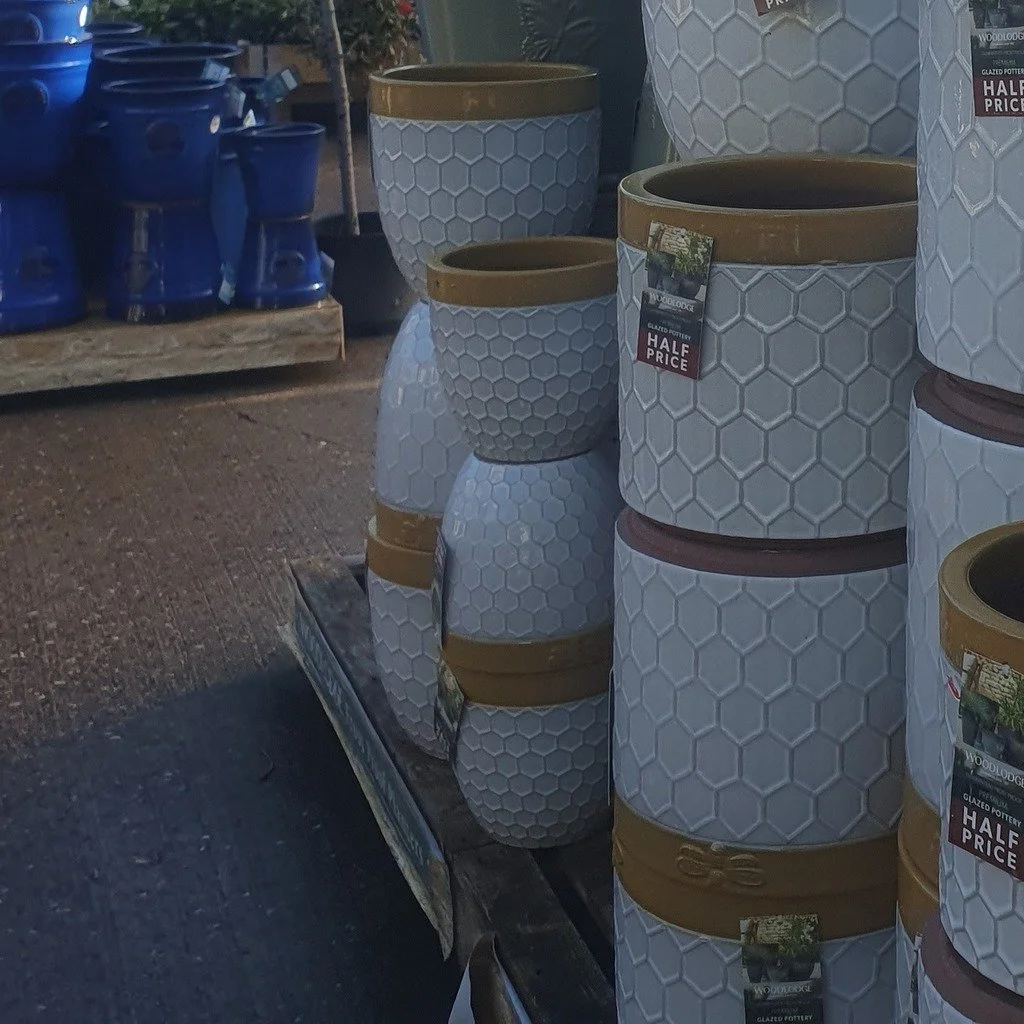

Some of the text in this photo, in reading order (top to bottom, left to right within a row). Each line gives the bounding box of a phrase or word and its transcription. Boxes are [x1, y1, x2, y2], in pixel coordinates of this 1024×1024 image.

[982, 68, 1003, 76] GLAZED
[650, 291, 695, 313] WOODLODGE
[647, 322, 669, 334] GLAZED
[668, 329, 692, 341] POTTERY
[647, 332, 689, 357] HALF
[646, 347, 688, 372] PRICE
[963, 792, 1022, 827] GLAZED POTTERY
[962, 805, 1019, 849] HALF
[961, 826, 1017, 870] PRICE
[784, 1014, 812, 1022] POTTERY
